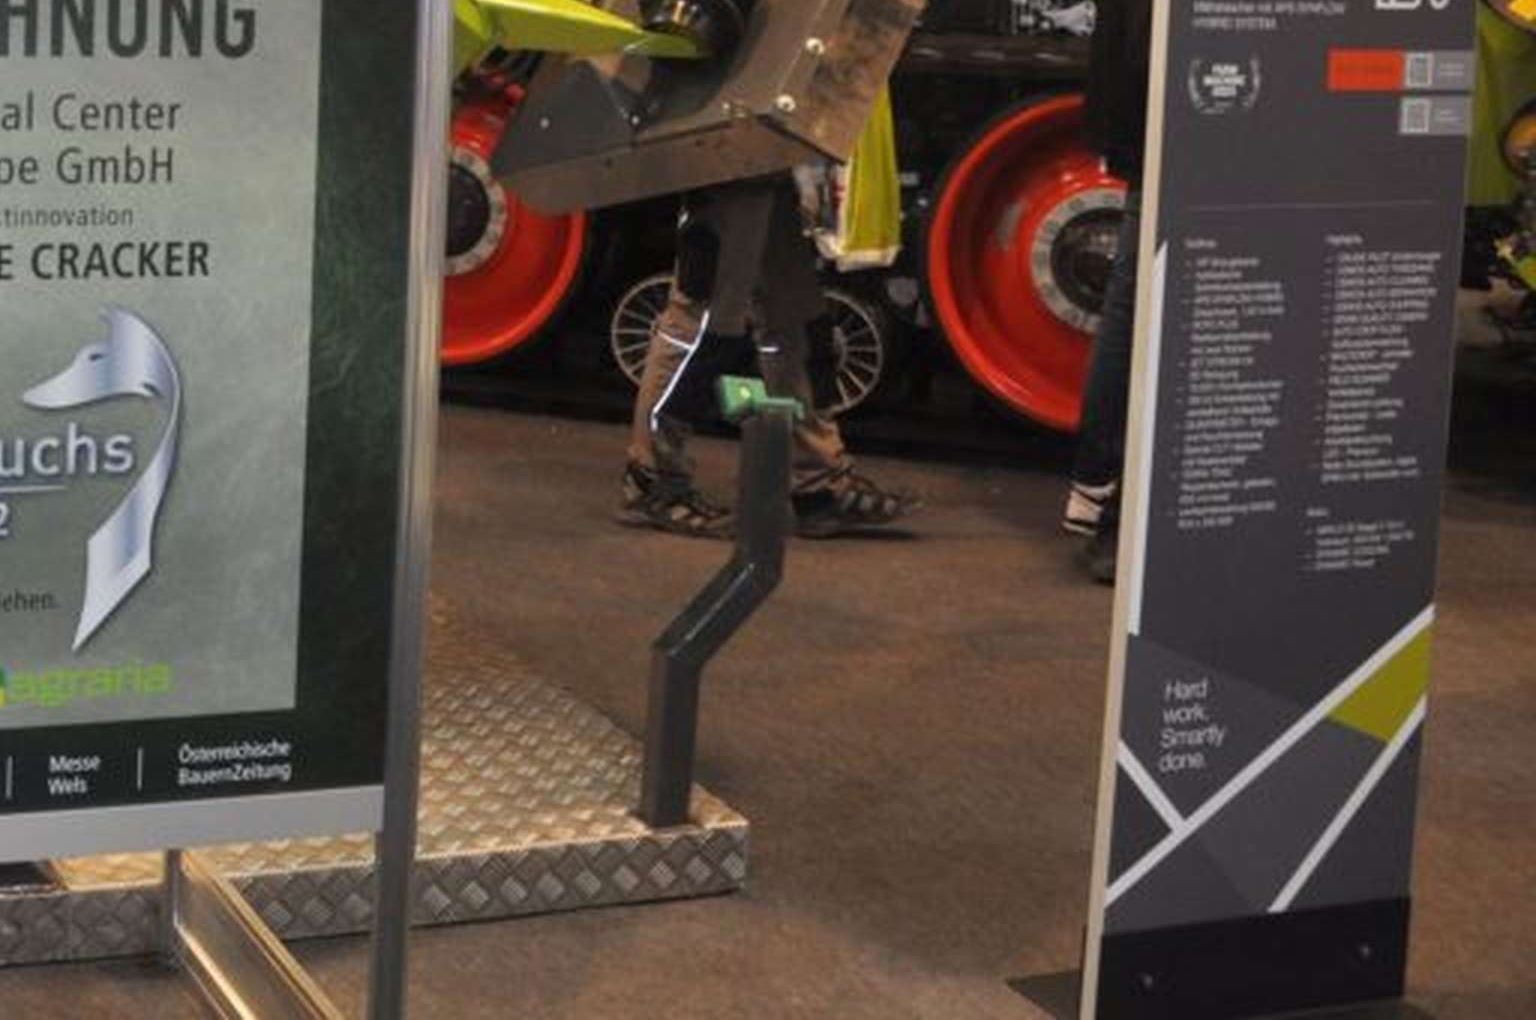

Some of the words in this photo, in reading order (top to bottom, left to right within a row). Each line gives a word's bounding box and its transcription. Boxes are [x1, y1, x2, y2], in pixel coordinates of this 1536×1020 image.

[52, 94, 182, 132] Center
[57, 145, 174, 185] GmbH
[31, 242, 210, 280] CRACKER
[1165, 678, 1208, 700] Hard
[49, 755, 101, 773] Messe
[178, 740, 291, 764] Österreichische
[47, 777, 89, 796] Wels
